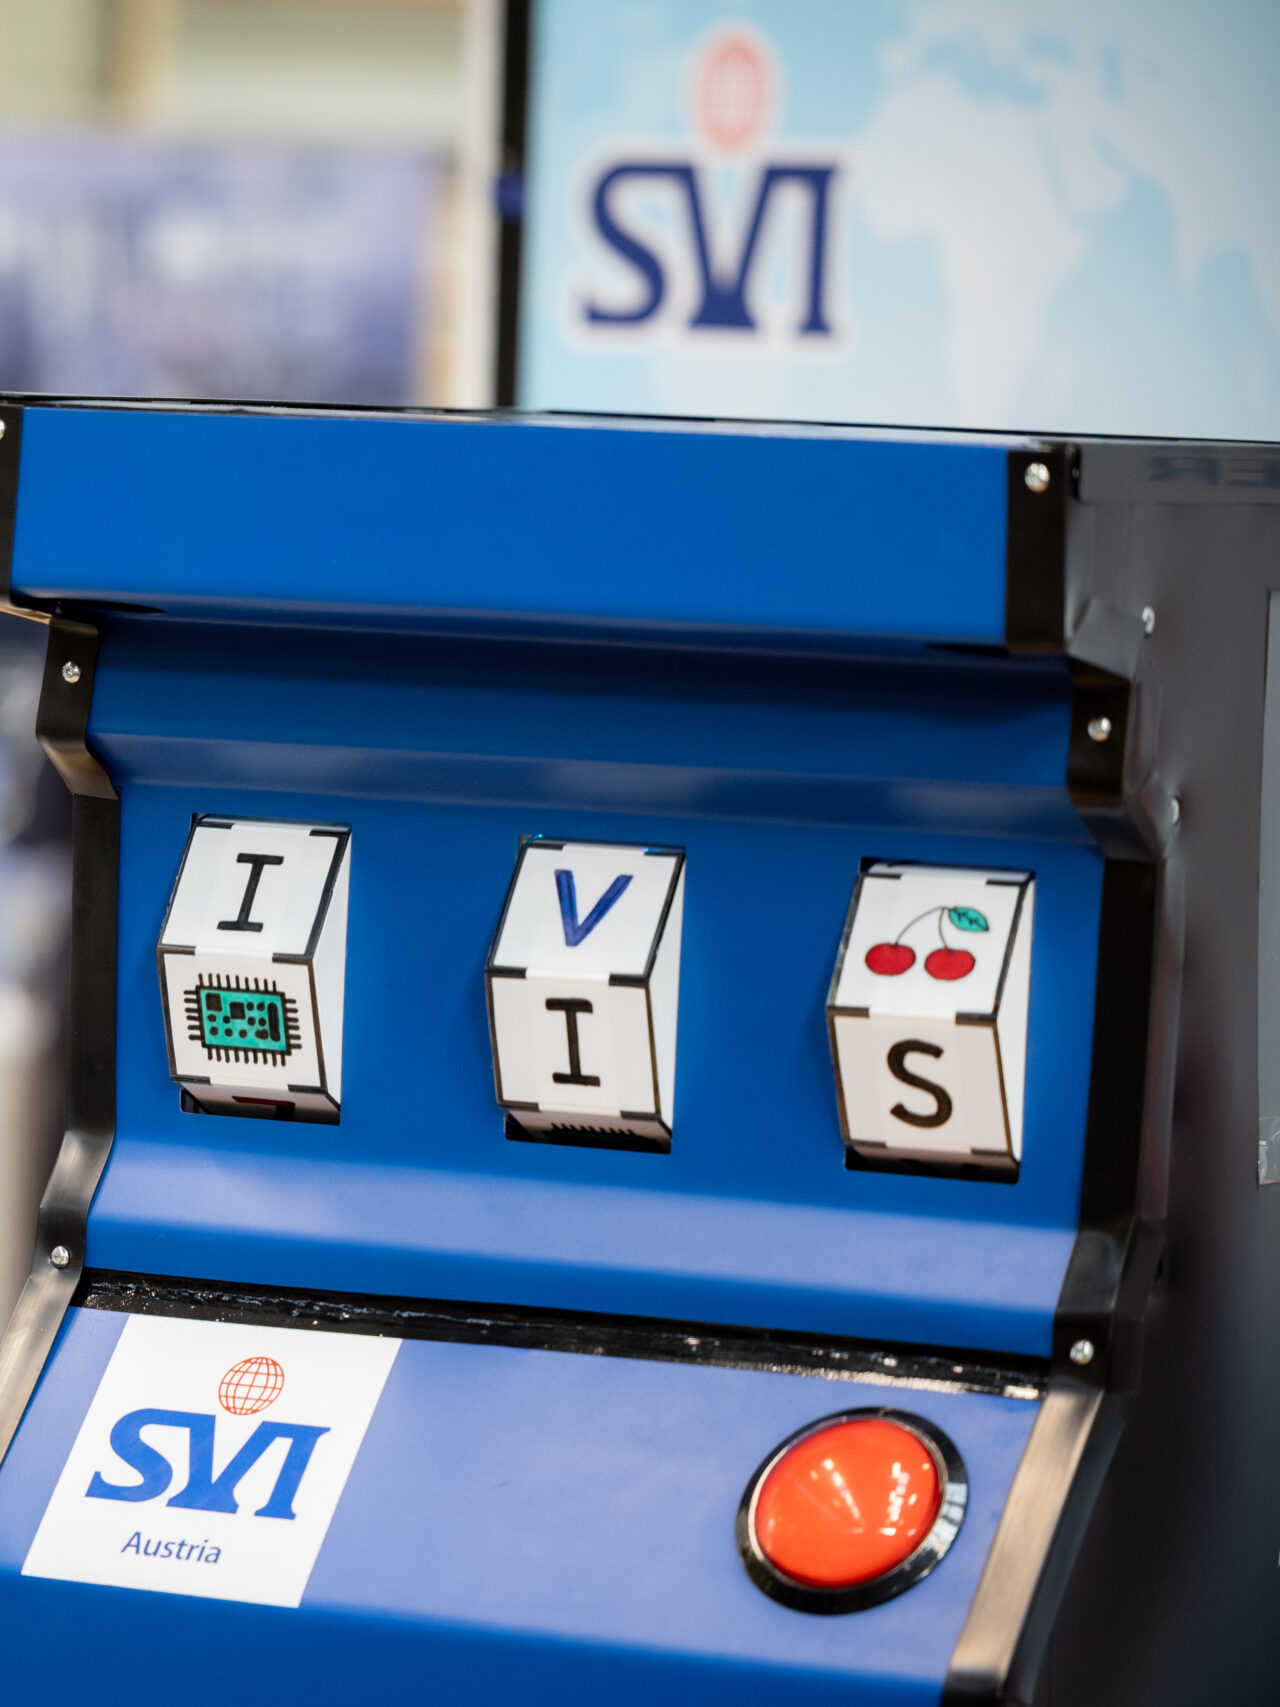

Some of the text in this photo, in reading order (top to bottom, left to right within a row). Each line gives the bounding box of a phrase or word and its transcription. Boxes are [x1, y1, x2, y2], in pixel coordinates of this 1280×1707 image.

[582, 162, 844, 333] SVI
[216, 853, 285, 933] I
[554, 868, 634, 948] V
[544, 997, 601, 1088] I
[886, 1039, 954, 1129] S
[85, 1408, 331, 1520] SVI
[121, 1531, 222, 1564] Austria
